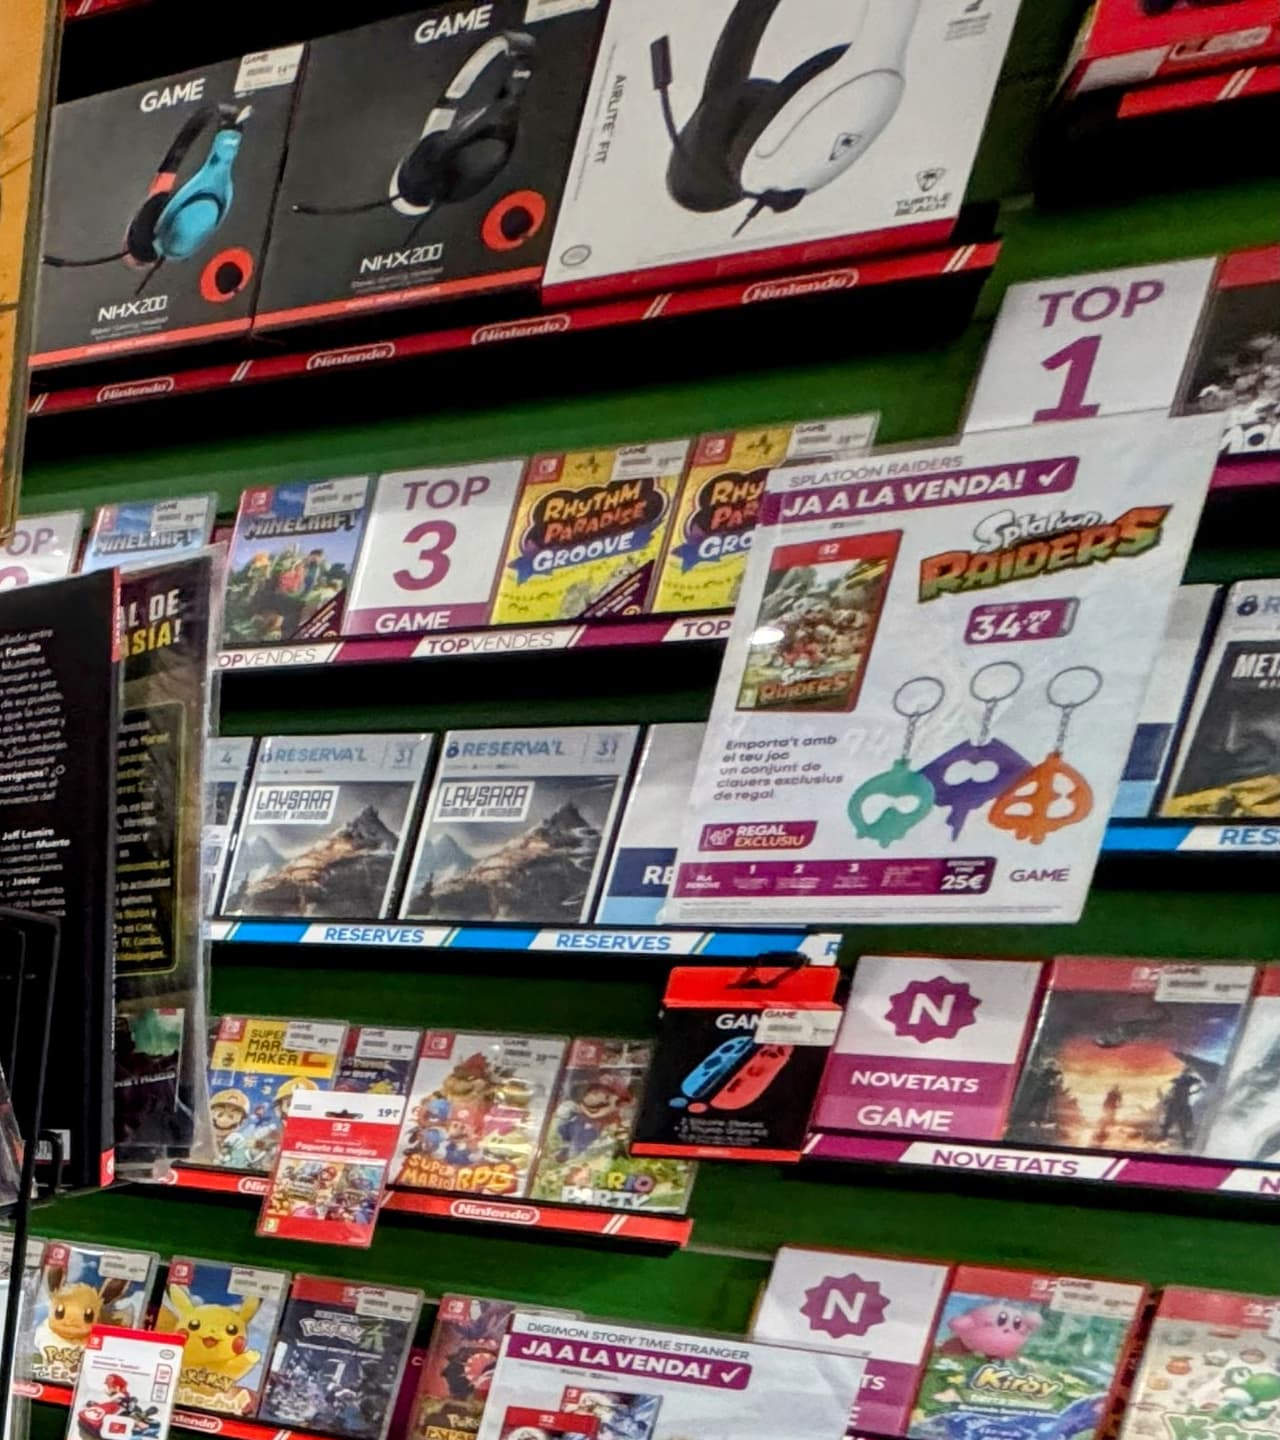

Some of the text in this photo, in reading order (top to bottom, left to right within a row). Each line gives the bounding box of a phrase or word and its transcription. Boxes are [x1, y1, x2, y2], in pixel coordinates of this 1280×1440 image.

[414, 3, 491, 45] GAME
[140, 78, 206, 114] GAME
[605, 73, 627, 133] AIRLITE
[894, 199, 948, 218] BEACH
[360, 243, 443, 274] NHX200
[750, 272, 853, 300] Nintendo
[97, 294, 167, 322] NHX200
[1037, 279, 1165, 328] TOP
[1033, 334, 1103, 425] 1
[790, 456, 963, 487] SPLATOON RAIDERS
[402, 475, 491, 512] TOP
[543, 481, 641, 523] RHYTHM
[783, 469, 1024, 517] JA LA VENDA!
[245, 510, 358, 539] MINECRAFT
[543, 503, 647, 545] PARADISE
[973, 510, 1103, 553] Splatoon
[392, 520, 458, 592] 3
[532, 531, 635, 573] GROOVE
[918, 504, 1172, 603] RAIDERS
[149, 590, 180, 618] DE
[375, 610, 451, 636] GAME
[429, 629, 555, 656] TOPVENDES
[275, 746, 368, 764] RESERVA'L
[462, 738, 566, 760] RESERVA'L
[723, 750, 790, 762] el teu joc
[726, 735, 837, 750] Emporta't amb
[717, 773, 843, 788] clauers exclusius
[720, 762, 821, 776] un conjunt de
[254, 785, 336, 814] LAYSARA
[439, 782, 533, 811] LAYSARA
[713, 789, 774, 800] de regal
[735, 835, 806, 847] EXCLUSIU
[736, 825, 786, 836] REGAL
[940, 874, 984, 890] 25€
[1009, 868, 1071, 883] GAME
[324, 925, 425, 946] RESERVES
[555, 931, 673, 952] RESERVES
[909, 994, 957, 1028] N
[244, 1052, 298, 1066] MAKER
[850, 1070, 980, 1094] NOVETATS
[857, 1104, 954, 1132] GAME
[408, 1154, 456, 1176] SUPER
[932, 1149, 1080, 1176] NOVETATS
[458, 1203, 531, 1221] Nintendo
[824, 1289, 860, 1324] N
[527, 1322, 750, 1360] DIGIMON STORY TIME STRANGER
[522, 1340, 552, 1358] JA
[580, 1349, 610, 1366] LA
[616, 1352, 712, 1380] VENDA!
[973, 1367, 1060, 1396] Kirby
